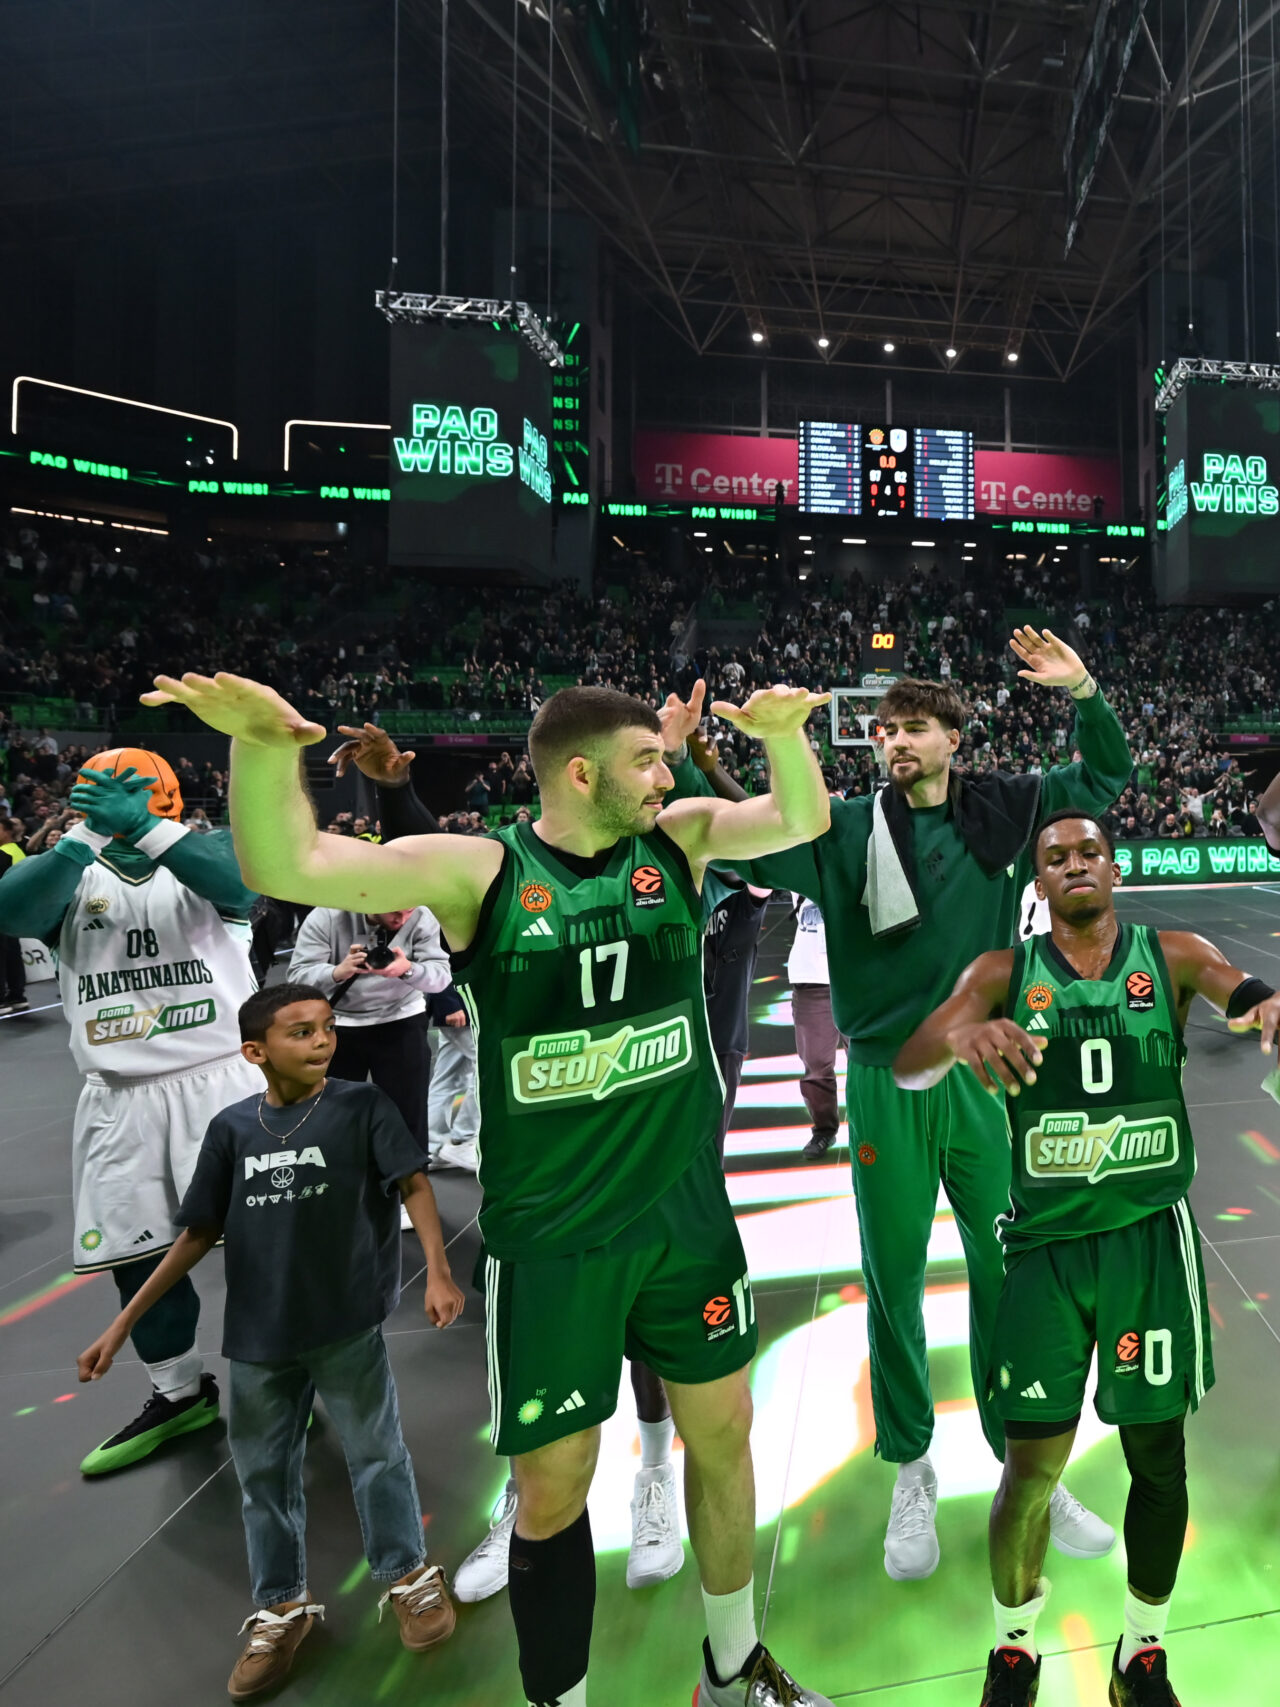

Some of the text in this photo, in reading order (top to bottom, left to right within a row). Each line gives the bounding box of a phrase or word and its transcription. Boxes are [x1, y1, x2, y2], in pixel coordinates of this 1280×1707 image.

[412, 403, 498, 441] PAO
[30, 451, 67, 469] PAO
[393, 437, 514, 477] WINS
[1204, 453, 1267, 485] PAO
[189, 481, 218, 493] PAO
[321, 486, 349, 498] PAO
[655, 463, 683, 495] T
[690, 467, 793, 497] Center
[563, 493, 589, 504] PAO
[981, 481, 1006, 510] T
[1012, 485, 1103, 512] Cente
[1190, 482, 1279, 515] WINS
[692, 507, 716, 518] PAO
[1012, 522, 1034, 532] PAO
[1107, 526, 1128, 536] PAO
[1142, 847, 1199, 875] PAO
[126, 928, 159, 959] 08
[78, 958, 213, 1005] PANATHINAIKOS
[579, 940, 629, 1008] 17
[100, 1006, 131, 1020] pame
[538, 1037, 580, 1056] pame
[1081, 1038, 1113, 1094] 0
[1046, 1118, 1080, 1134] pame
[245, 1146, 327, 1180] NBA
[1145, 1328, 1172, 1386] 0
